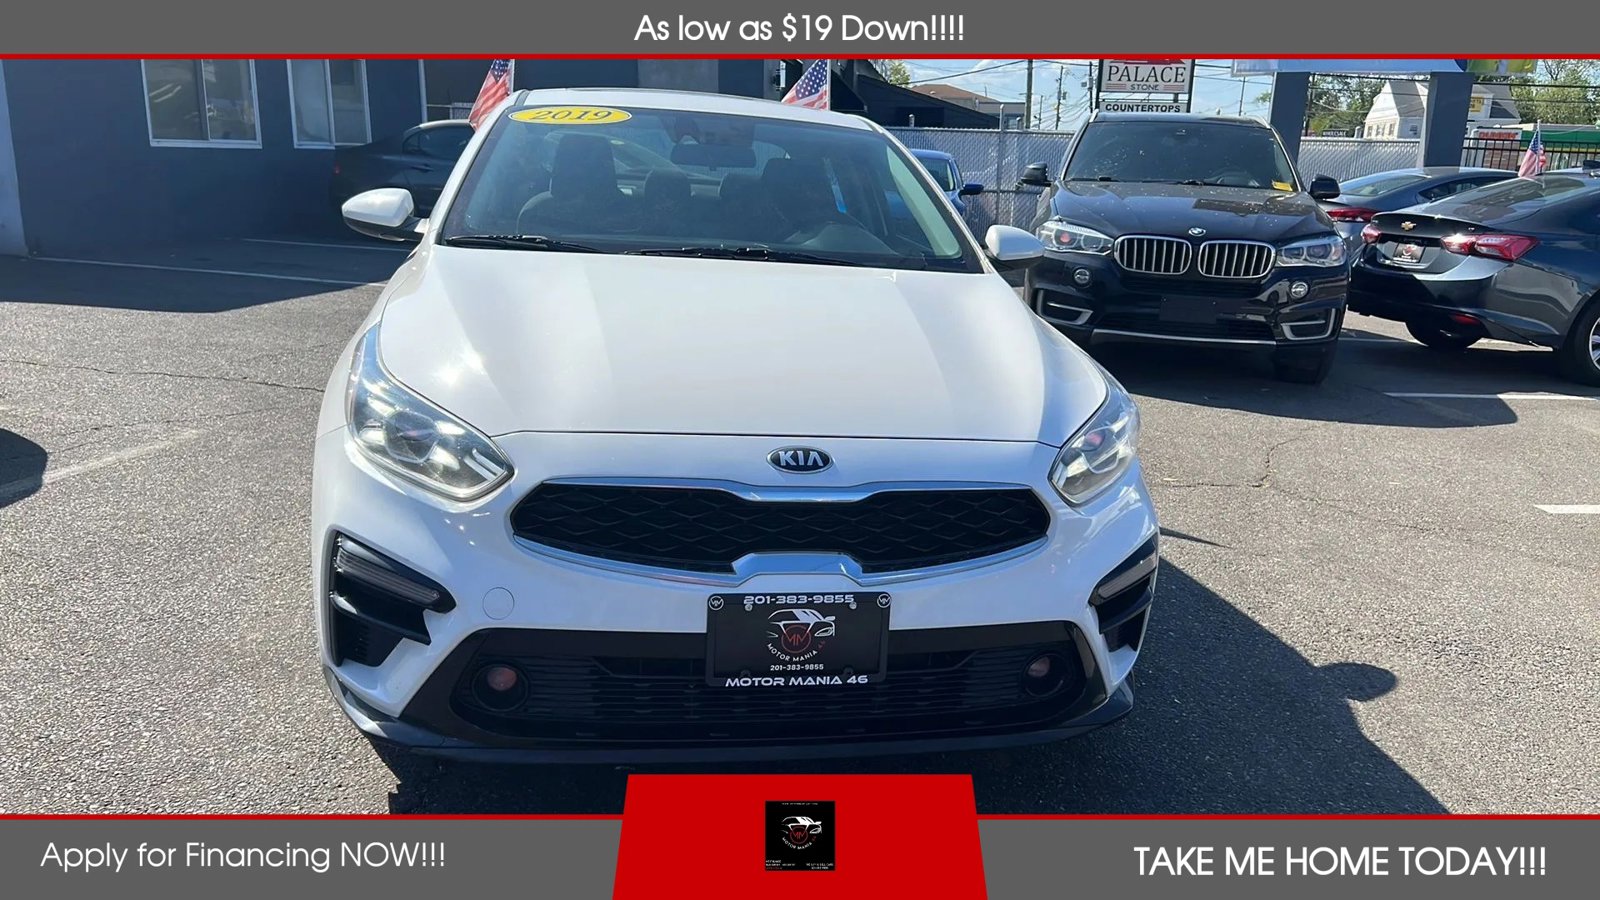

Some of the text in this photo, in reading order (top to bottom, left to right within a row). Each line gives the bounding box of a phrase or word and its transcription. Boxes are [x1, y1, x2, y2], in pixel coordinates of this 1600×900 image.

[1107, 65, 1186, 83] PALACE
[1130, 83, 1160, 91] STONE
[1105, 103, 1181, 113] COUNTERTOPS
[530, 109, 613, 121] 2019
[778, 450, 824, 467] KIA
[743, 594, 855, 605] 201-383-9855
[766, 643, 791, 661] MOTOR
[792, 650, 818, 662] MANIA
[769, 663, 825, 671] 201-383-9855
[725, 674, 869, 688] MOTOR MANIA 46
